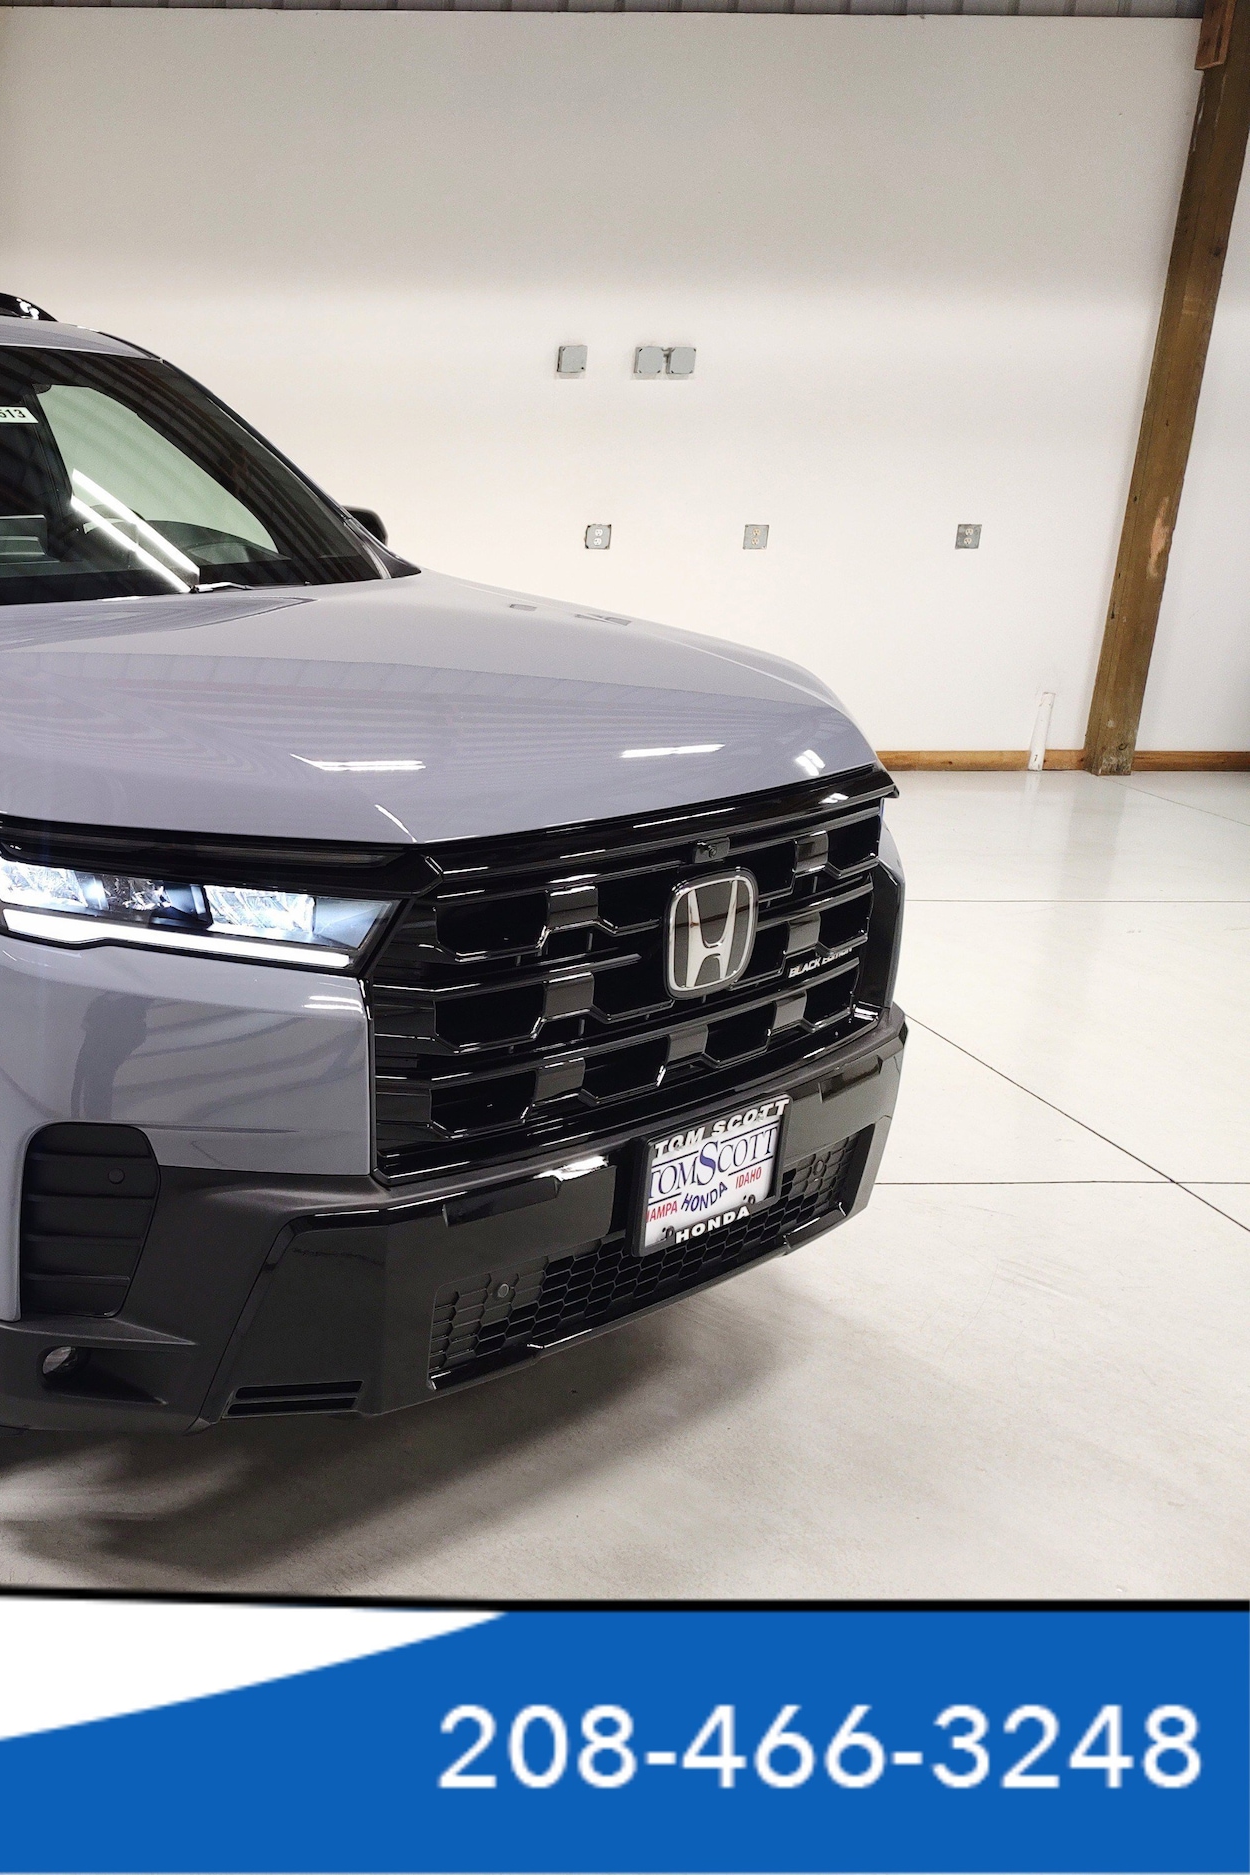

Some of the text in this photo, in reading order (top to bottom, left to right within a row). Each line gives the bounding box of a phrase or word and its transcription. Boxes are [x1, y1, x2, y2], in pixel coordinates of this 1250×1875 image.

[788, 957, 821, 979] BLACK
[654, 1098, 790, 1160] TOM SCOTT
[680, 1181, 728, 1212] HONDA
[735, 1166, 762, 1189] IDAHO
[675, 1205, 750, 1244] HONDA
